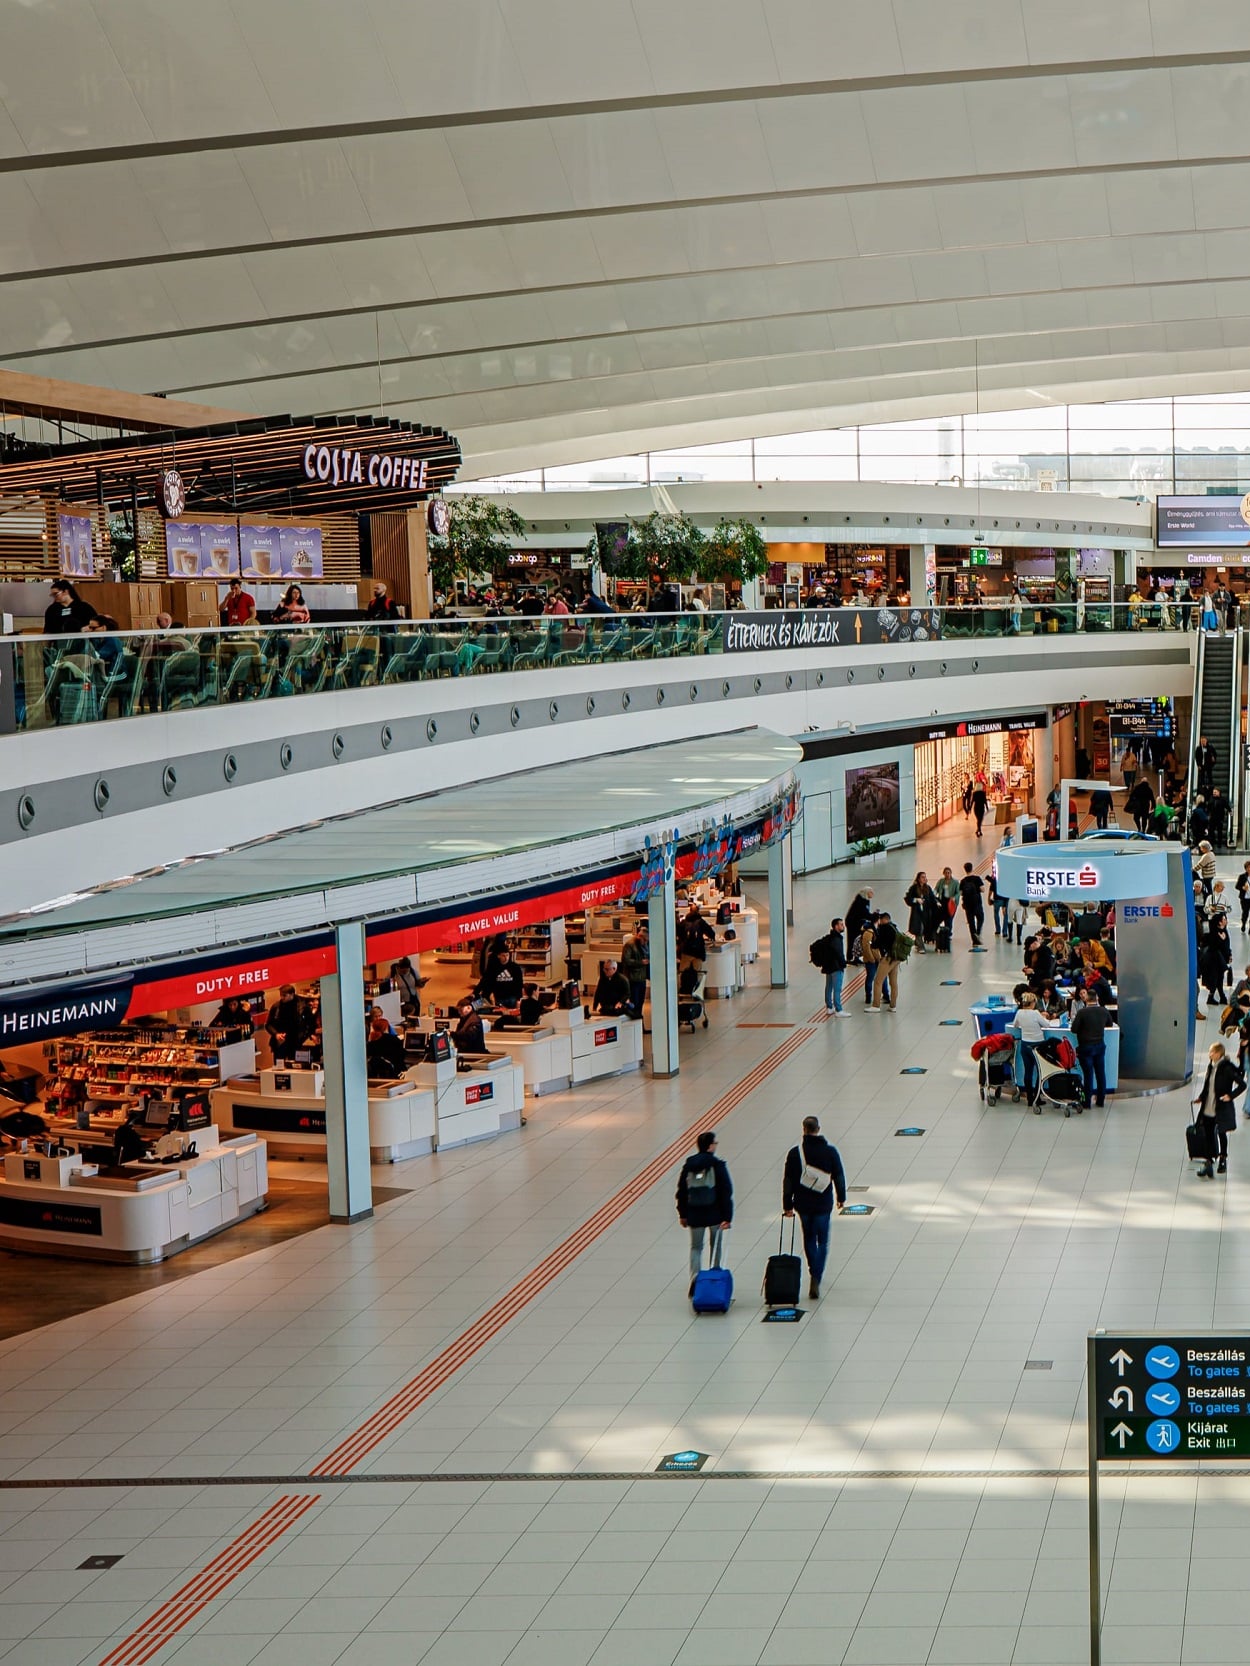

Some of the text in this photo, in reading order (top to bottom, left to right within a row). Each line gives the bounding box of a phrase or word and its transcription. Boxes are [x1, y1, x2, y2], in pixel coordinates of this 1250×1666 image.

[304, 444, 428, 489] COSTA COFFEE
[1187, 554, 1222, 563] Camden
[727, 613, 840, 649] ÉTTERMEK ÉS KÁVÉZÓK
[968, 723, 1002, 734] HEINEMANN
[1026, 871, 1076, 886] ERSTE
[581, 884, 616, 903] DUTY FREE
[1026, 887, 1046, 896] Bank
[1124, 906, 1159, 917] ERSTE
[458, 910, 519, 935] TRAVEL VALUE
[196, 968, 269, 995] DUTY FREE
[3, 998, 116, 1034] HEINEMANN
[1187, 1350, 1245, 1362] Beszállás
[1188, 1366, 1240, 1379] To gates
[1187, 1386, 1246, 1399] Beszállás
[1188, 1403, 1240, 1416] To gates
[1188, 1422, 1228, 1435] Kijárat
[1188, 1437, 1211, 1448] Exit
[1216, 1437, 1236, 1448] 出口
